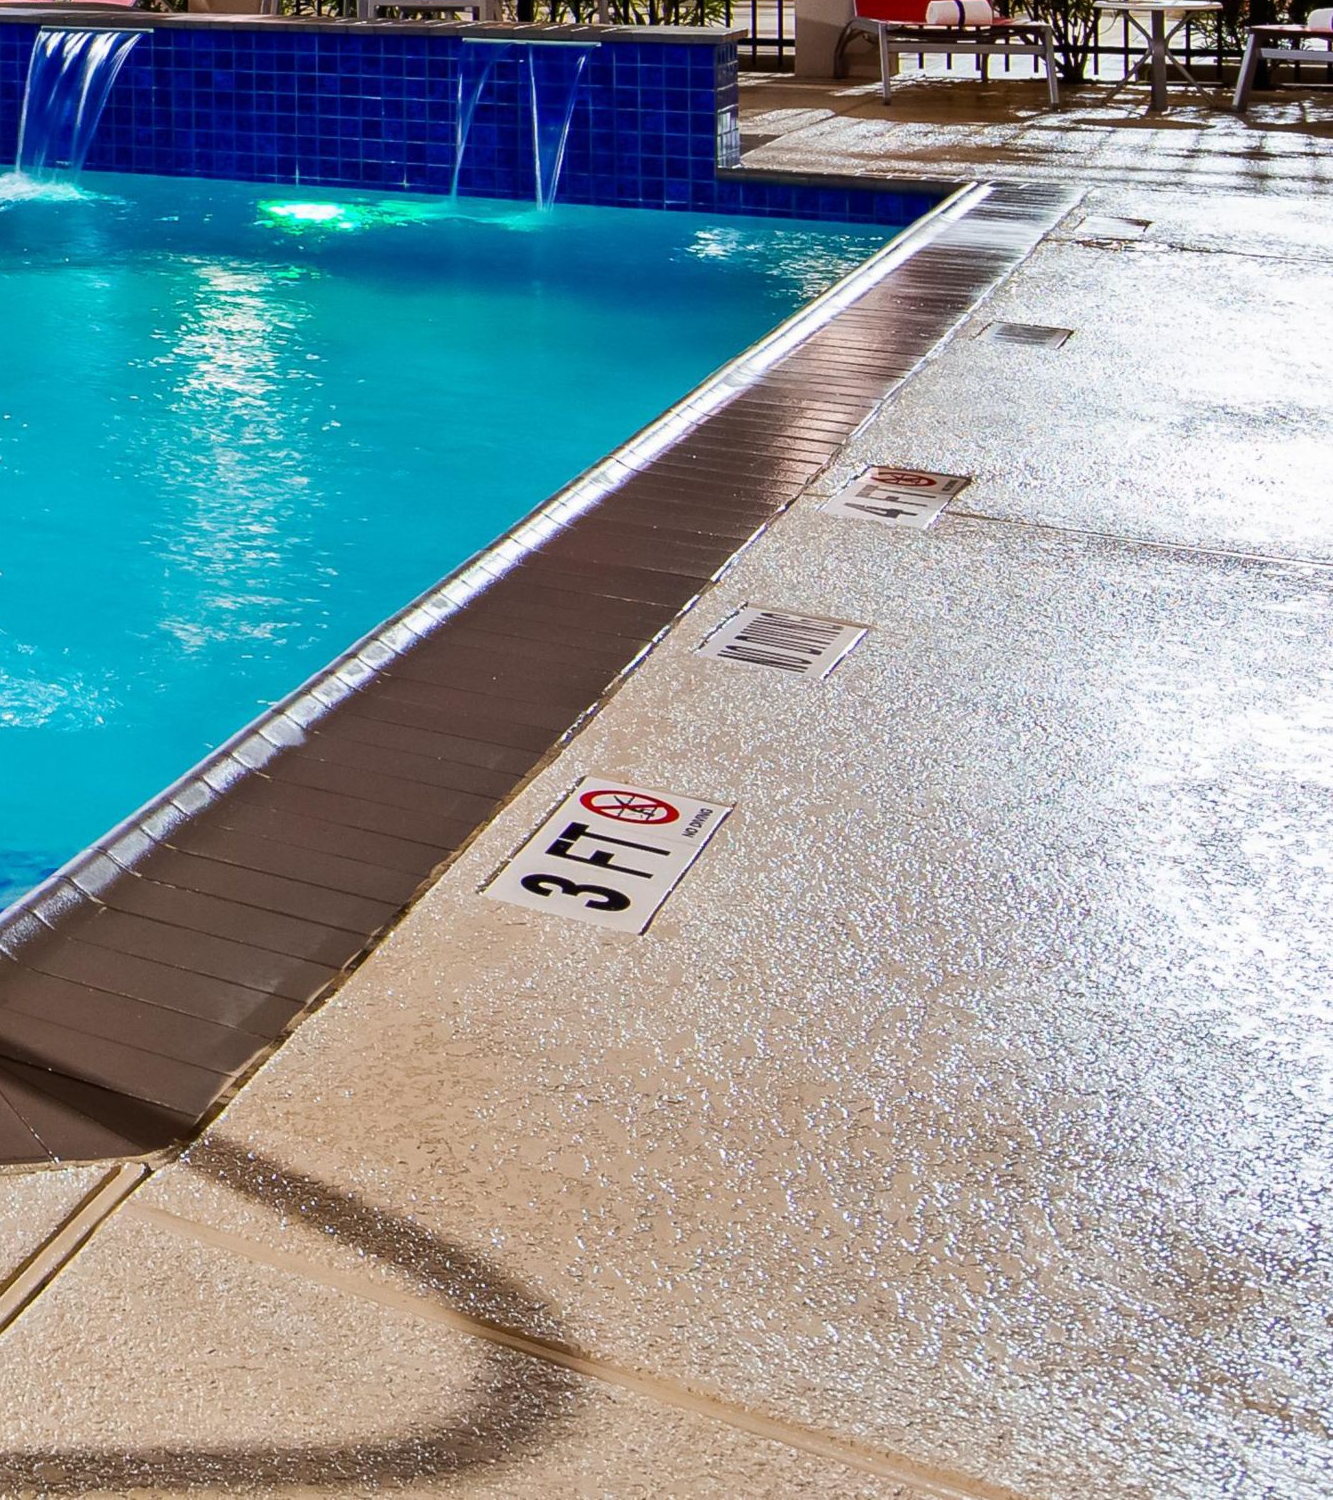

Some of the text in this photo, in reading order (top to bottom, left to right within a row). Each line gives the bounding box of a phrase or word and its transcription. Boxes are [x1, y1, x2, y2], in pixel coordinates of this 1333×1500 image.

[844, 502, 918, 519] 4
[855, 484, 937, 507] FT
[717, 612, 845, 673] NO DIVING
[681, 808, 714, 839] NO DIVING
[520, 822, 671, 912] 3 FT
